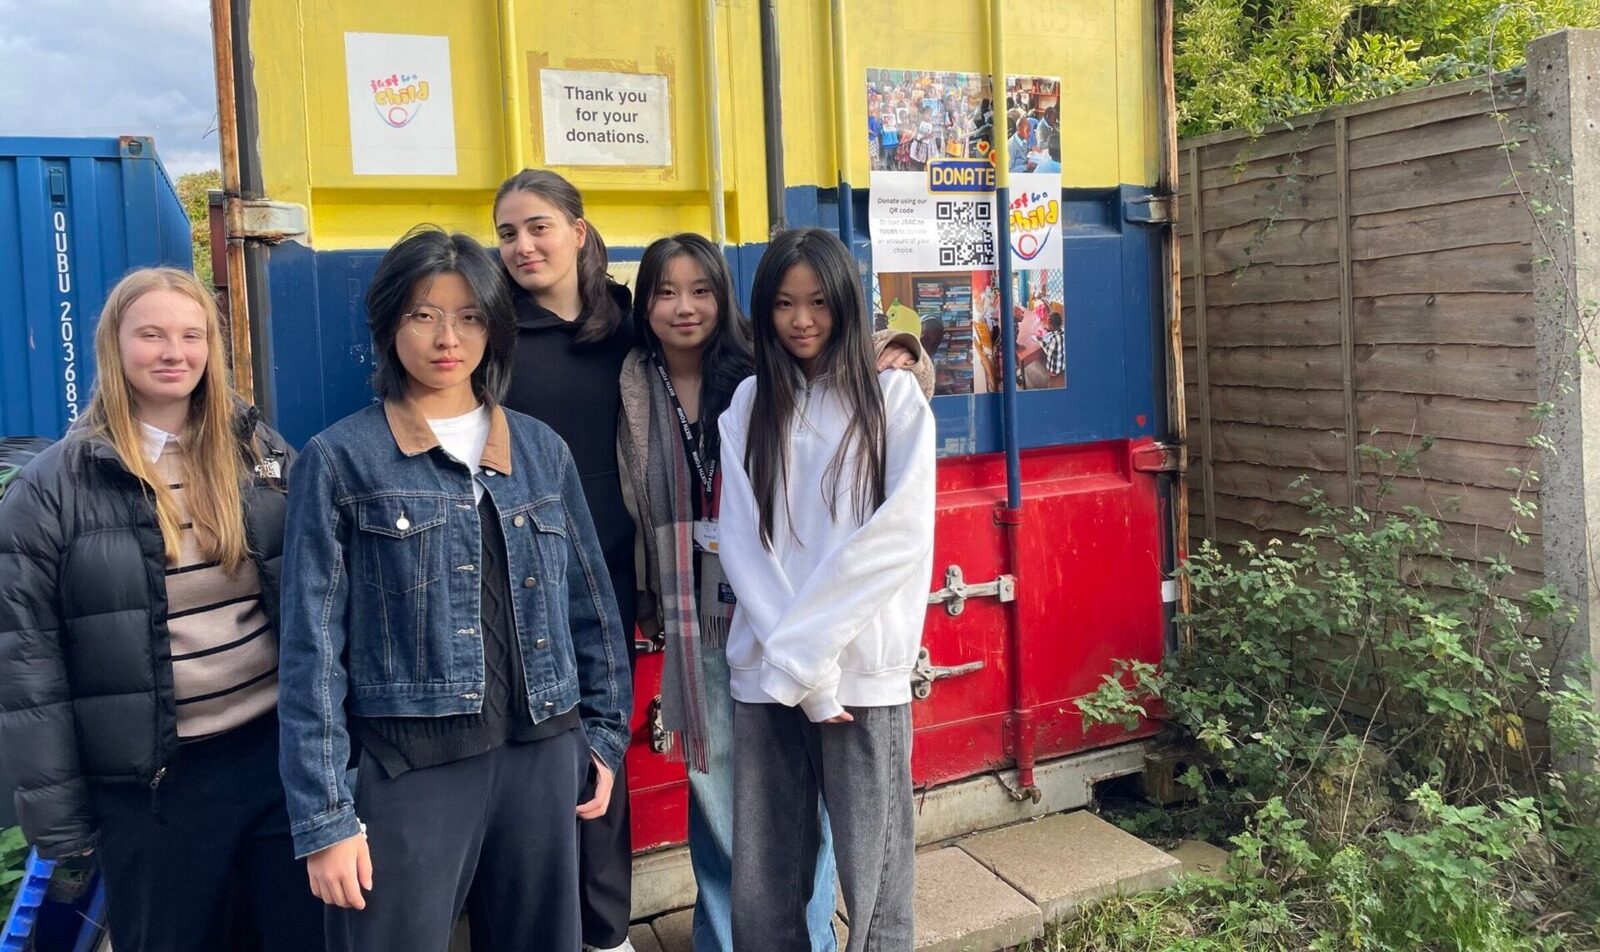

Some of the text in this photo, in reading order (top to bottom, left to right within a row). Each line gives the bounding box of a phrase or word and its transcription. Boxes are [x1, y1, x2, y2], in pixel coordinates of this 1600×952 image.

[374, 80, 430, 106] child
[564, 86, 647, 107] Thank you
[575, 106, 638, 125] for your
[566, 128, 649, 145] donations.
[931, 167, 995, 187] DONATE
[900, 198, 916, 206] using
[54, 212, 71, 293] QUBU
[60, 302, 79, 423] 203683
[676, 407, 692, 440] SIXTH FORM
[692, 451, 703, 469] FORM
